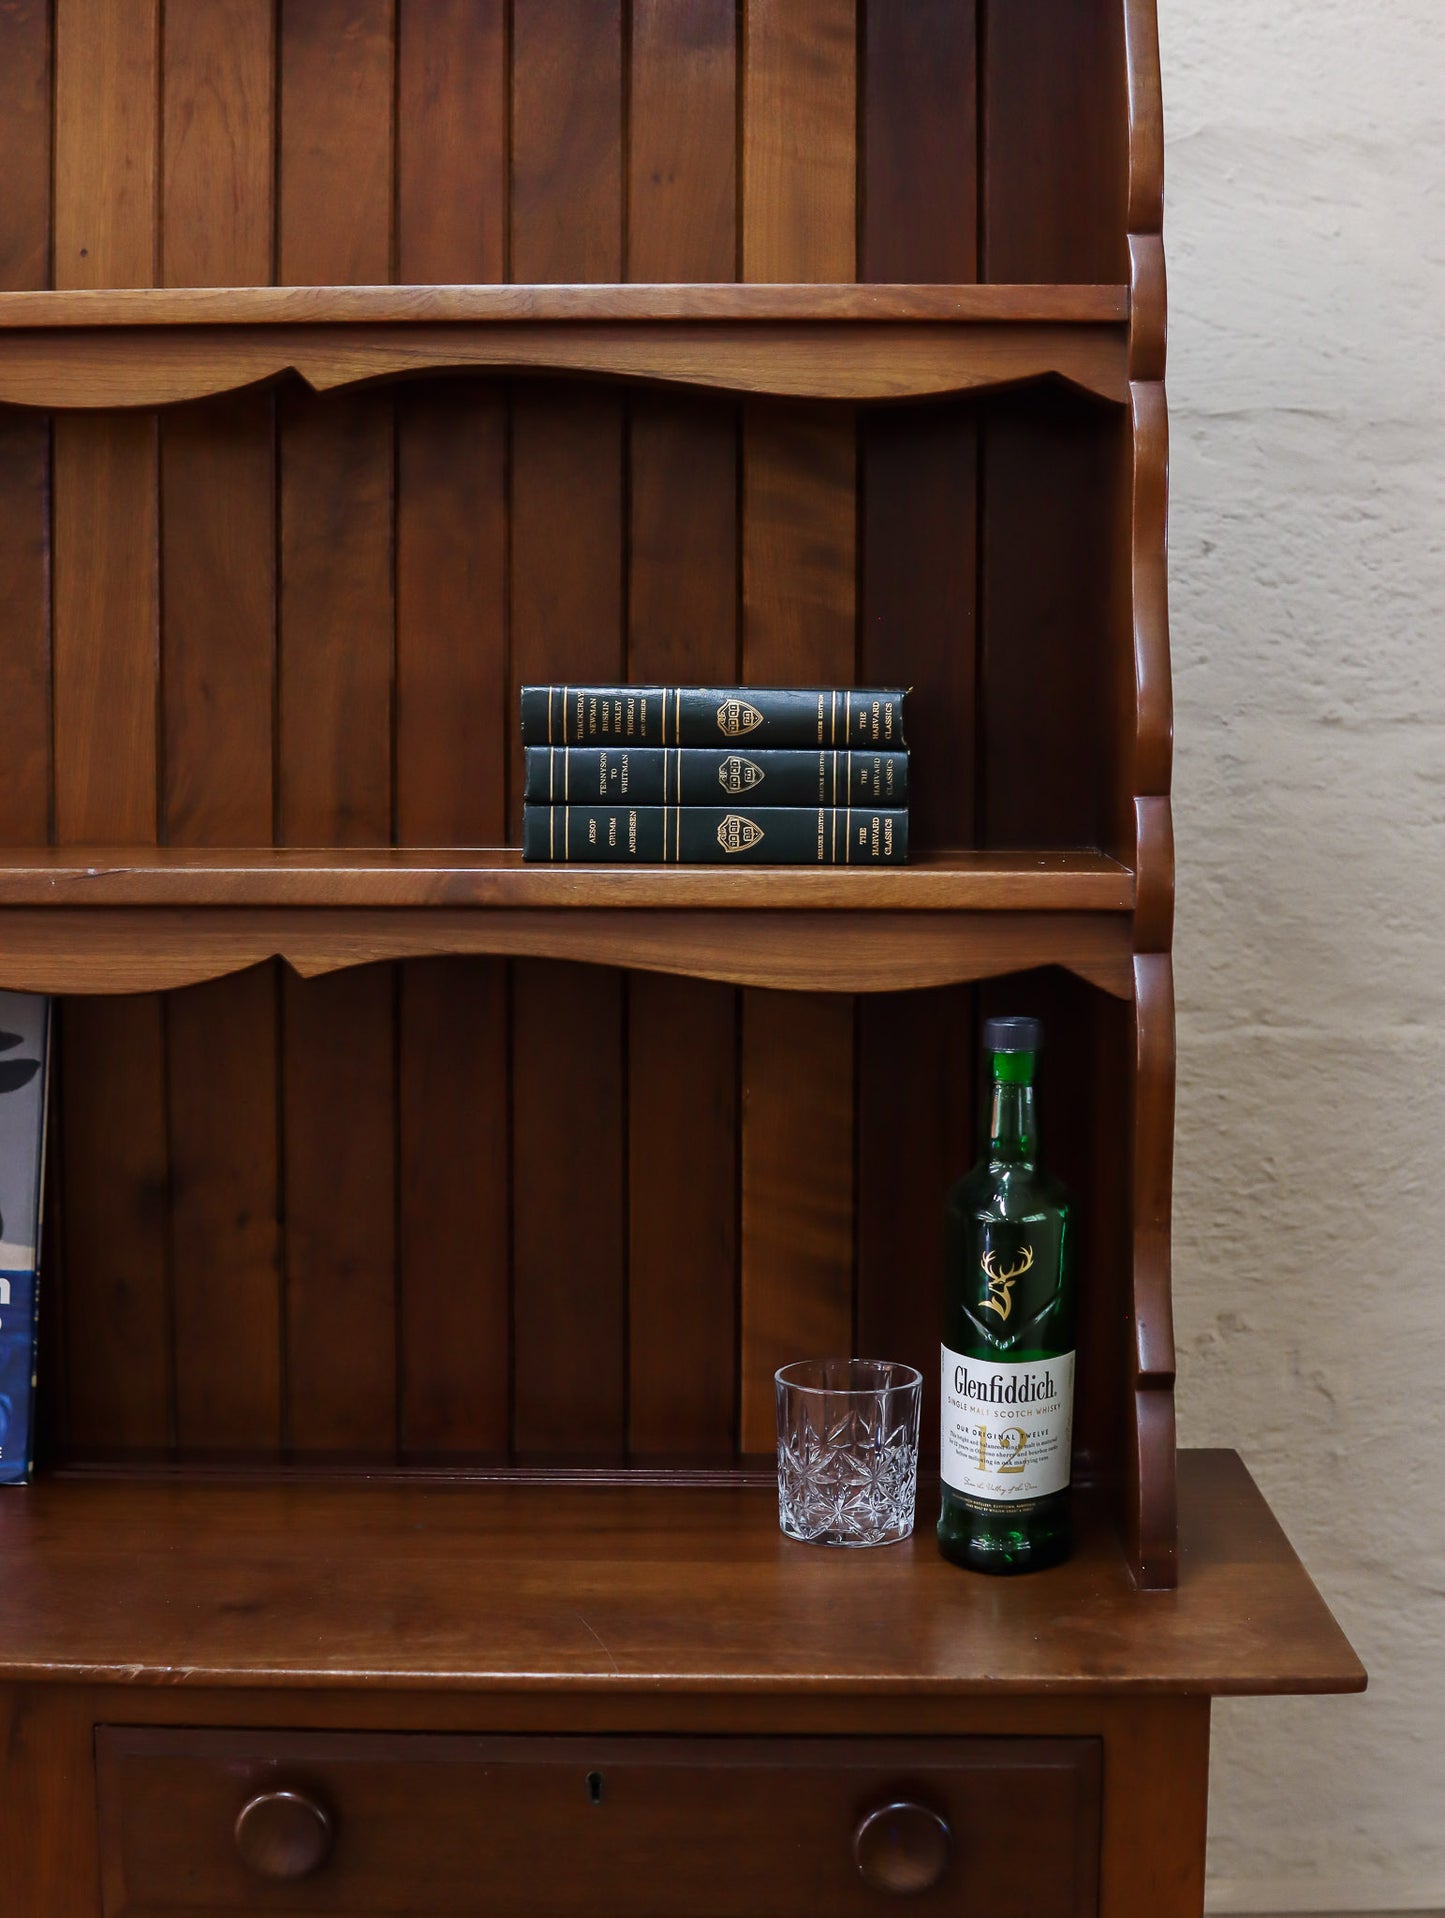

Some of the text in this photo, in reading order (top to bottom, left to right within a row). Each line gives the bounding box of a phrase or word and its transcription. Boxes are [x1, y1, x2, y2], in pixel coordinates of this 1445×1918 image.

[614, 700, 622, 733] HUXLEY
[627, 698, 635, 736] THOREAU
[872, 701, 880, 740] HARVARD
[611, 768, 617, 779] TO
[609, 817, 617, 846] GRIMM
[629, 810, 637, 854] ANDERSEN
[872, 817, 880, 856] HARVARD
[884, 818, 892, 855] CLASSICS
[948, 1396, 1061, 1418] SINGLE MALT SCOTCH WHISKY
[957, 1424, 1048, 1440] OUR ORIGINAL TWELVE
[974, 1424, 1028, 1473] 12
